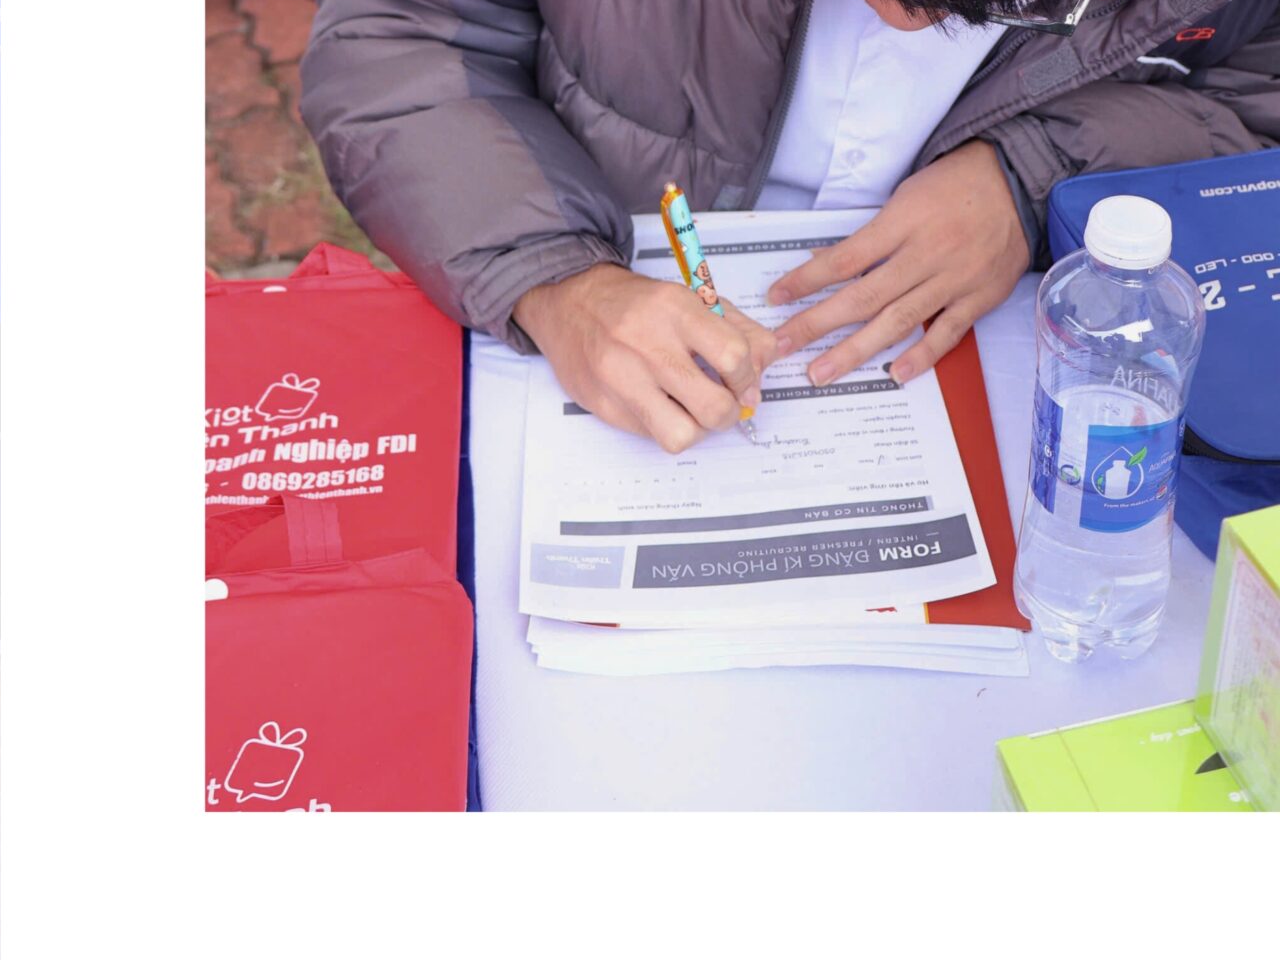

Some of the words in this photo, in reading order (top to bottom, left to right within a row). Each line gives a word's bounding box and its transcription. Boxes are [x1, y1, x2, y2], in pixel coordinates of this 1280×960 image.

[238, 412, 339, 445] Thanh
[273, 438, 370, 464] Nghiệp
[377, 433, 417, 456] FDI
[241, 464, 385, 491] 0869285168
[835, 507, 851, 516] CƠ
[856, 505, 876, 513] TIN
[881, 501, 923, 513] THÔNG
[812, 540, 864, 550] FRESHER
[877, 534, 919, 545] INTERN
[737, 544, 807, 557] RECRUITING
[808, 549, 870, 568] ĐĂNG
[879, 540, 942, 561] FORM
[652, 564, 696, 582] VẤN
[701, 558, 777, 579] PHỎNG
[783, 556, 802, 574] KÍ
